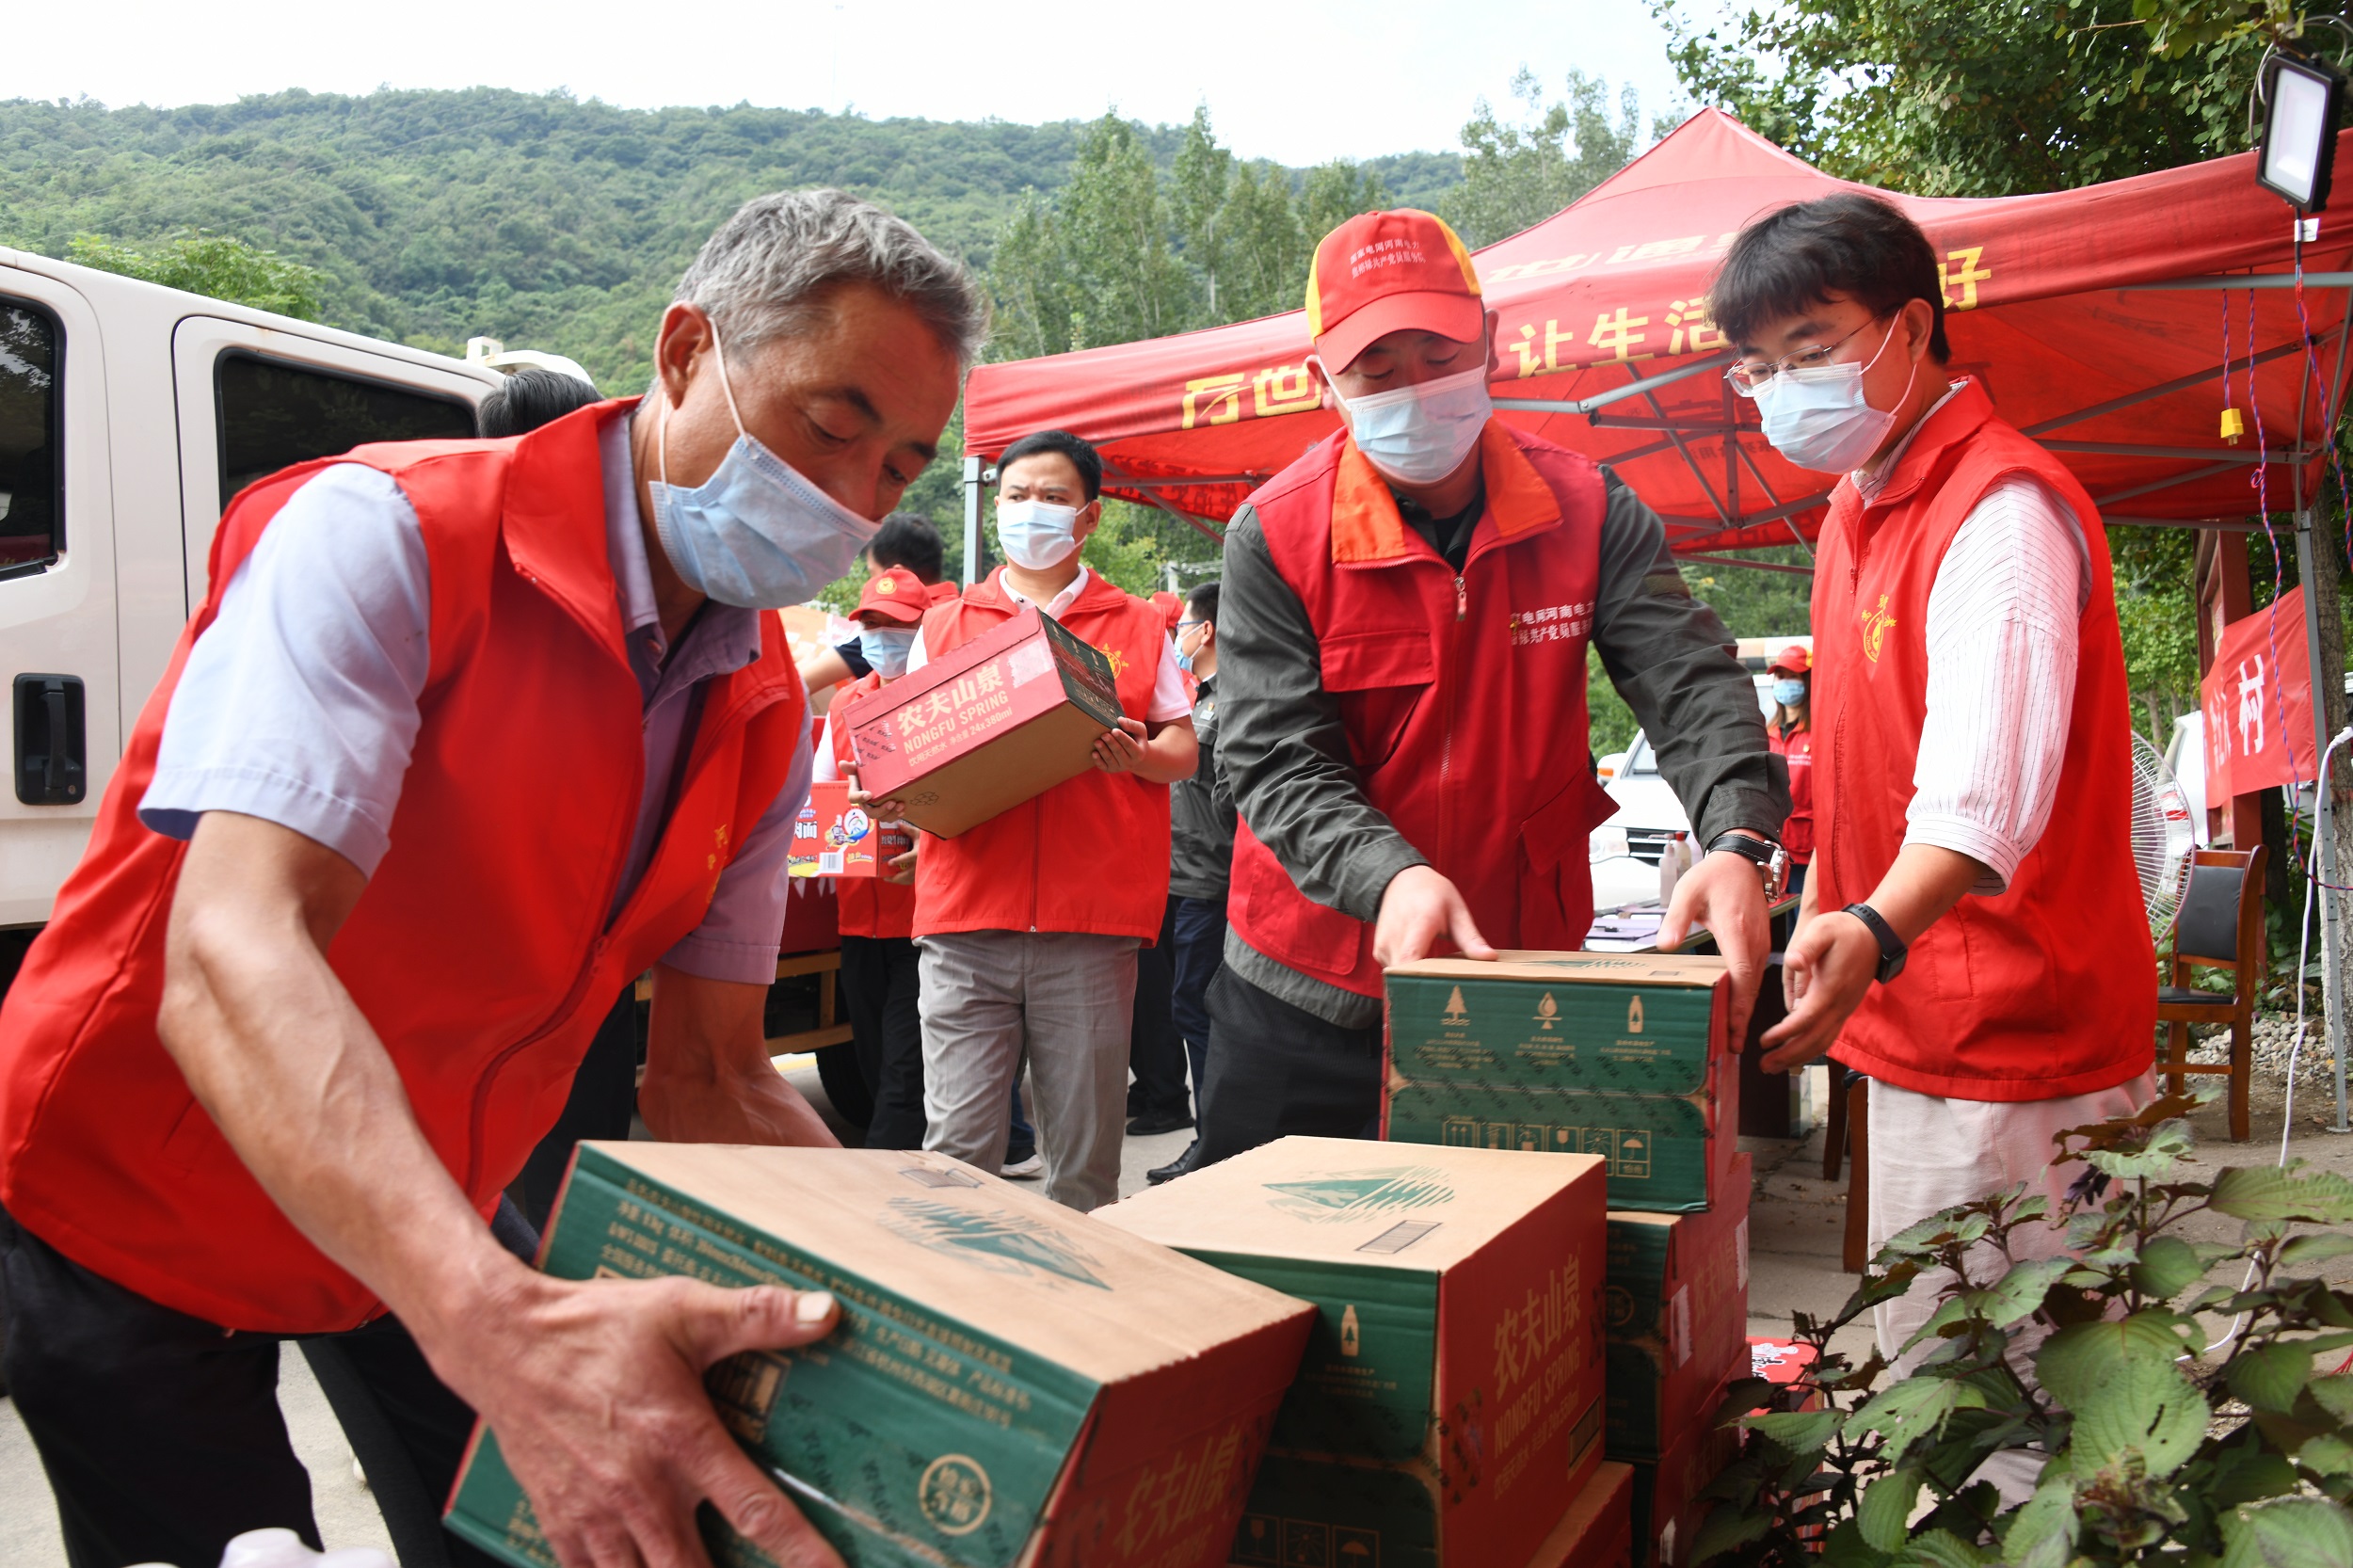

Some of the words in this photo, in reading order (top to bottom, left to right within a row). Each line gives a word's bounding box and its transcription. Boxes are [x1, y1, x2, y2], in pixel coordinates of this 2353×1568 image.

[897, 664, 1004, 737] 农夫山泉
[904, 717, 956, 755] NONGFU
[958, 690, 1009, 725] SPRING
[908, 742, 948, 767] 饮用天然水
[1494, 1253, 1580, 1403] 农夫山泉
[1495, 1377, 1541, 1459] NONGFU
[1544, 1336, 1581, 1404] SPRING
[1112, 1424, 1241, 1559] 农夫山泉
